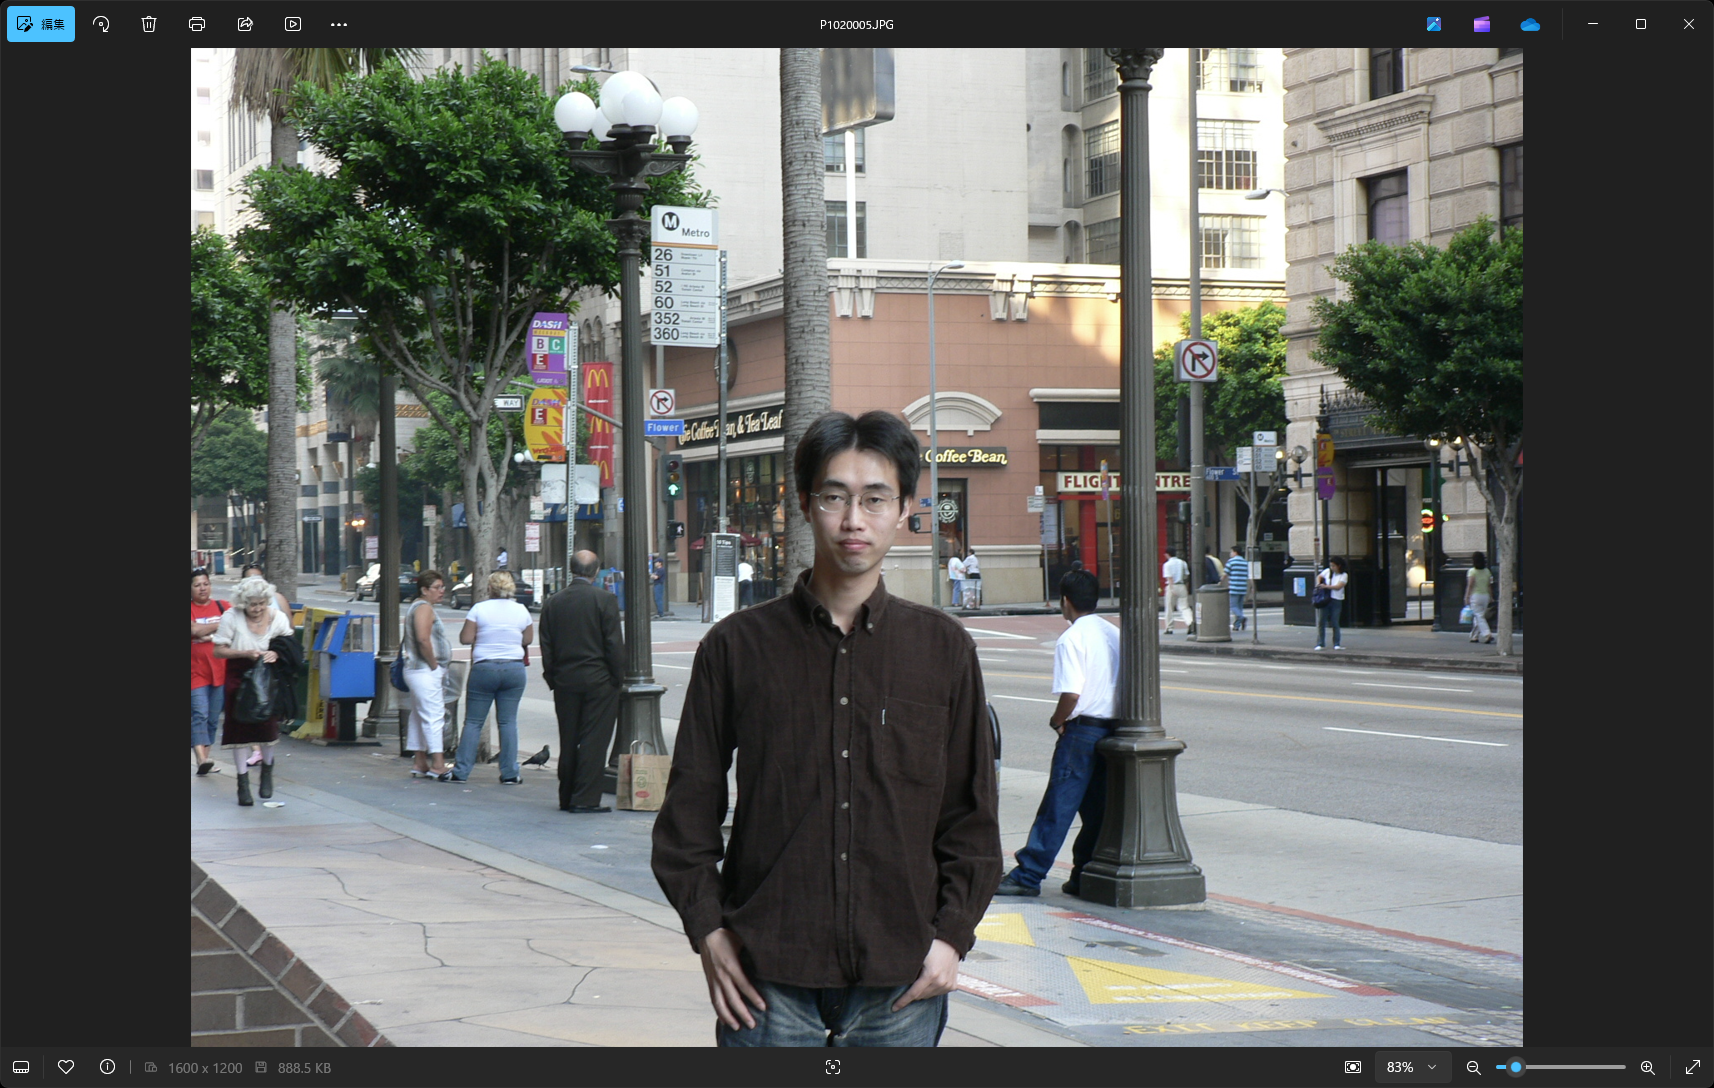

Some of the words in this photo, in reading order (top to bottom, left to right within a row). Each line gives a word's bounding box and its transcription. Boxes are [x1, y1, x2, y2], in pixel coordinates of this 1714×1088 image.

[41, 18, 65, 31] 編集
[820, 19, 894, 30] P1020005.JPG
[681, 228, 710, 238] Metro
[654, 248, 673, 261] 26
[654, 264, 670, 277] 51
[654, 280, 673, 293] 52
[654, 296, 674, 309] 60
[532, 320, 562, 329] DASH
[654, 312, 680, 325] 352
[653, 327, 680, 340] 360
[536, 339, 544, 349] B
[552, 339, 560, 350] C
[536, 354, 544, 365] E
[503, 399, 518, 407] WAY
[535, 408, 543, 420] E
[647, 423, 679, 432] Flower
[691, 421, 714, 441] Coffee
[737, 415, 745, 434] &
[745, 412, 760, 433] Tea
[760, 409, 783, 430] Leaf
[925, 449, 967, 463] Coffee
[967, 449, 1008, 465] Bean
[1123, 1022, 1216, 1035] EXIT
[1232, 1019, 1319, 1030] KEEP
[1343, 1016, 1457, 1026] CLEAR
[168, 1062, 199, 1075] 1600
[202, 1065, 209, 1075] x
[213, 1062, 243, 1075] 1200
[278, 1062, 312, 1075] 888.5
[315, 1062, 332, 1075] KB
[1387, 1062, 1414, 1073] 83%
